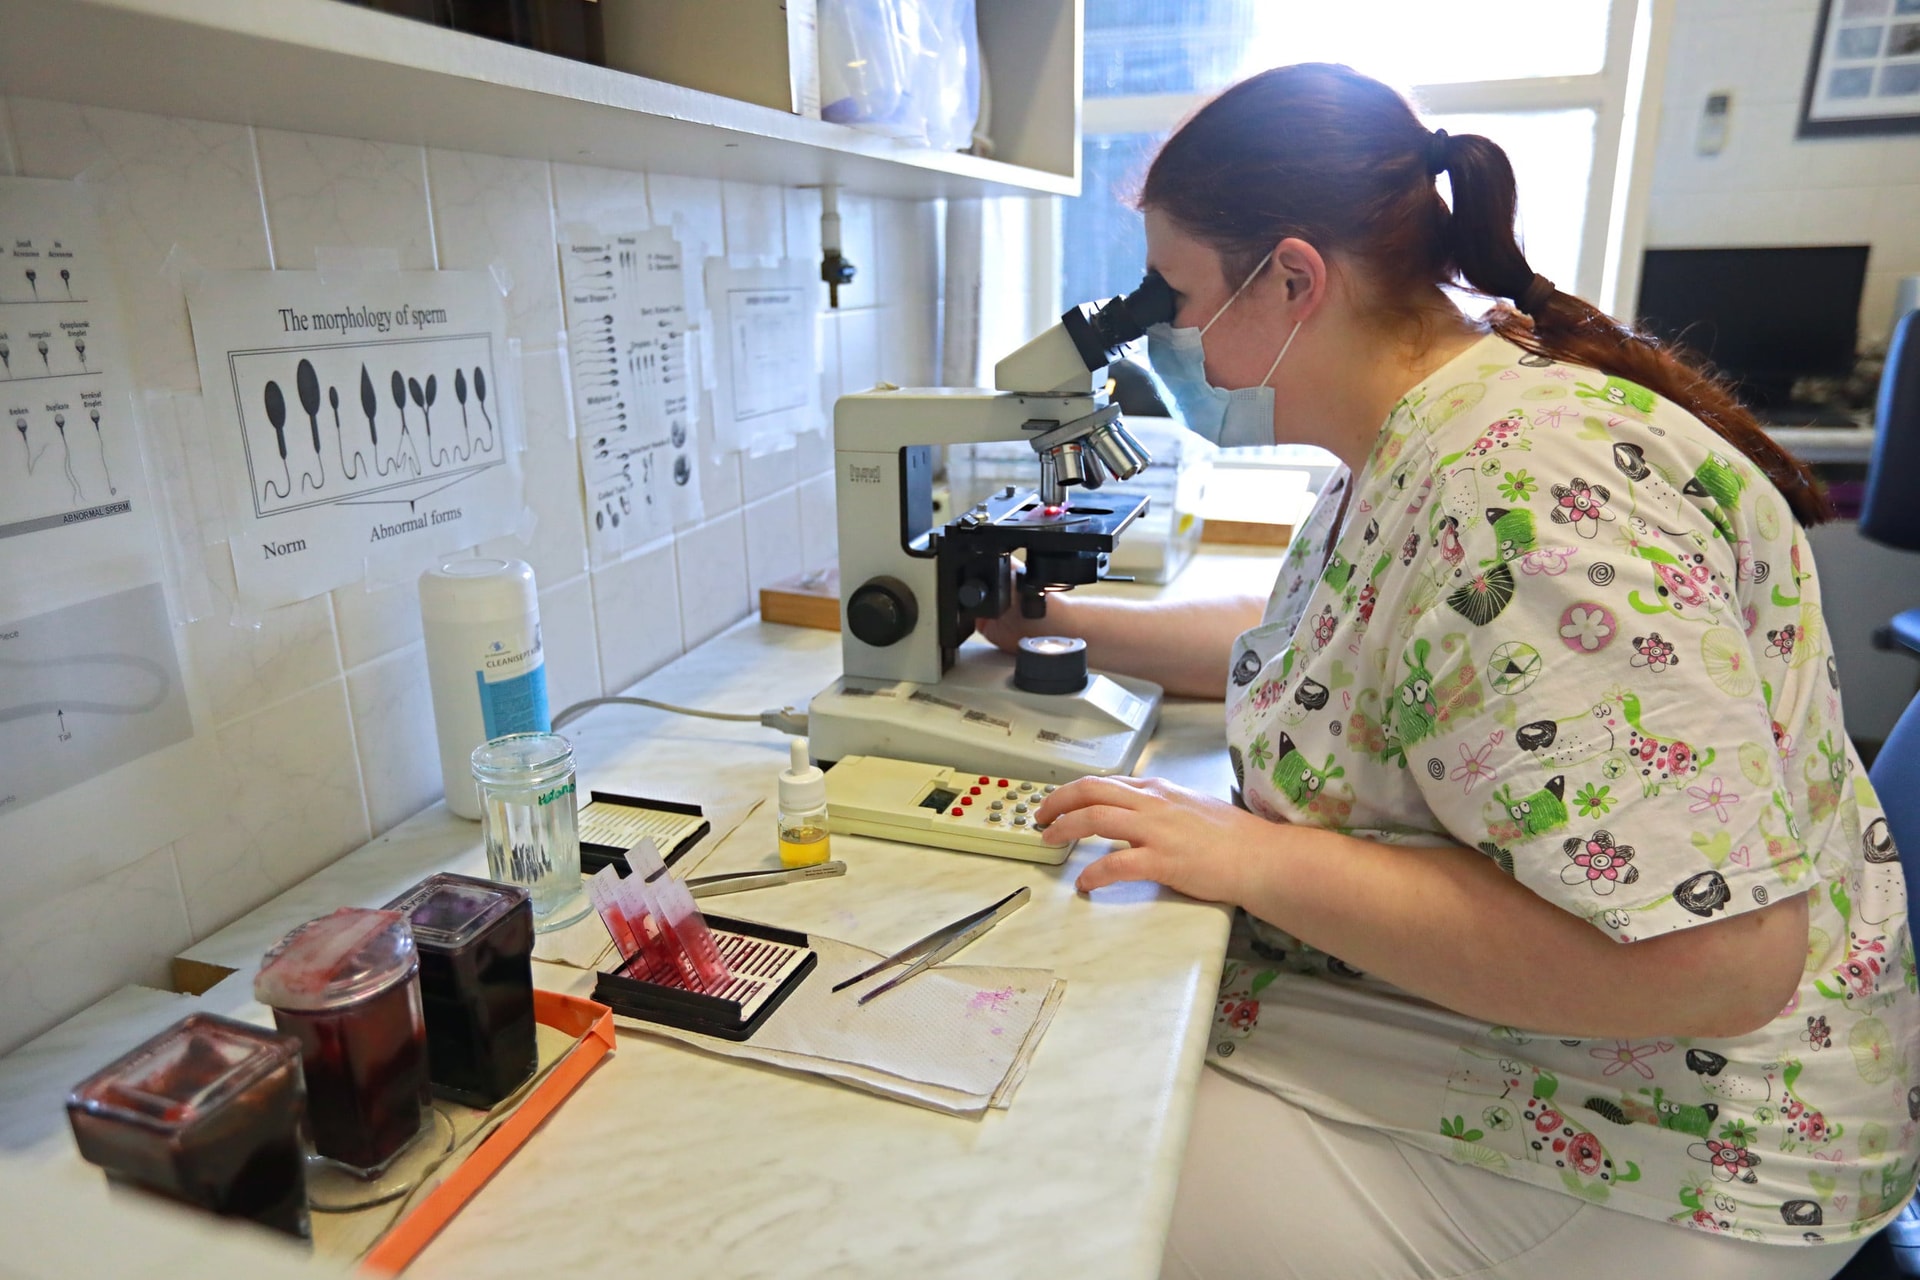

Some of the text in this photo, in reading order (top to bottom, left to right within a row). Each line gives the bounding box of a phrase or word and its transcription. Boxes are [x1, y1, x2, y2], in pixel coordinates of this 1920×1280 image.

[278, 304, 448, 335] The morphology of sperm
[63, 502, 130, 524] ABNORMAL SPERM
[370, 507, 463, 543] Abnormal forms
[262, 537, 307, 560] Norm
[58, 732, 72, 743] Tail
